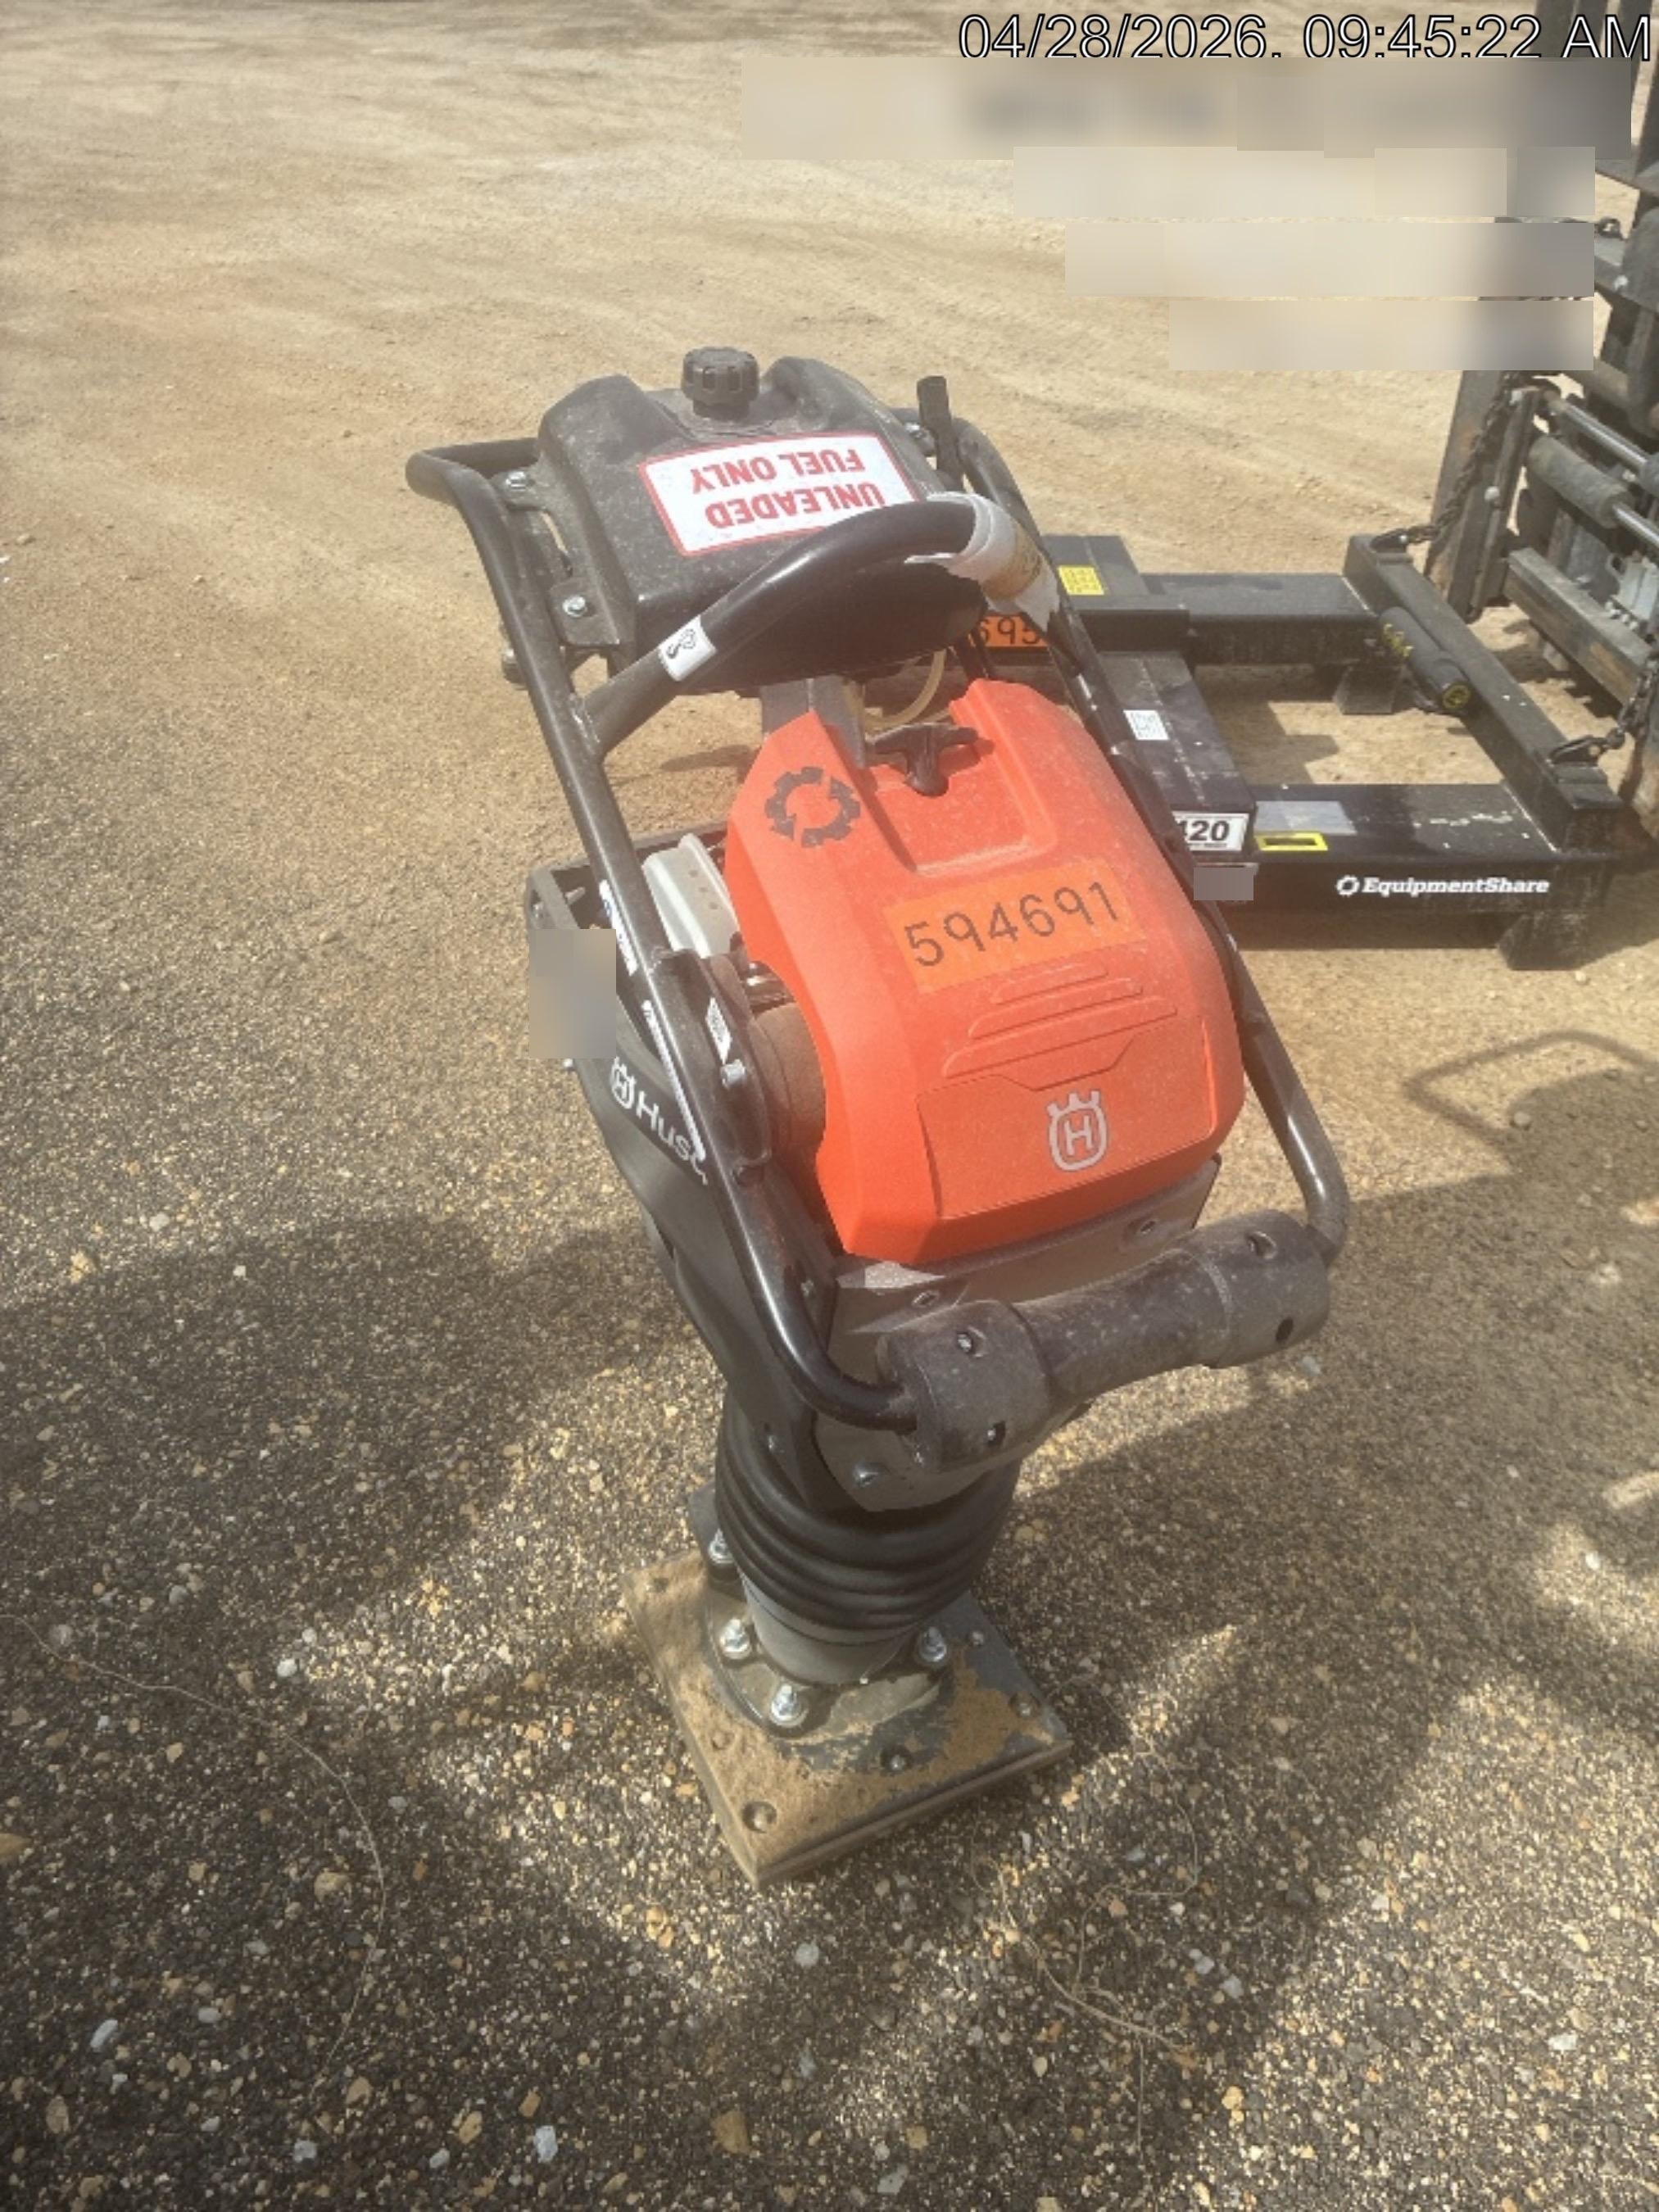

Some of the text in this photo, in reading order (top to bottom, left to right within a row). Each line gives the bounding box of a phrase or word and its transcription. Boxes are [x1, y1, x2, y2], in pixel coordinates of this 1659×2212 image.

[691, 449, 865, 494] FUEL ONLY
[705, 483, 886, 529] UNLEADED
[1362, 876, 1551, 898] EquipmentShare
[904, 881, 1119, 968] 594691
